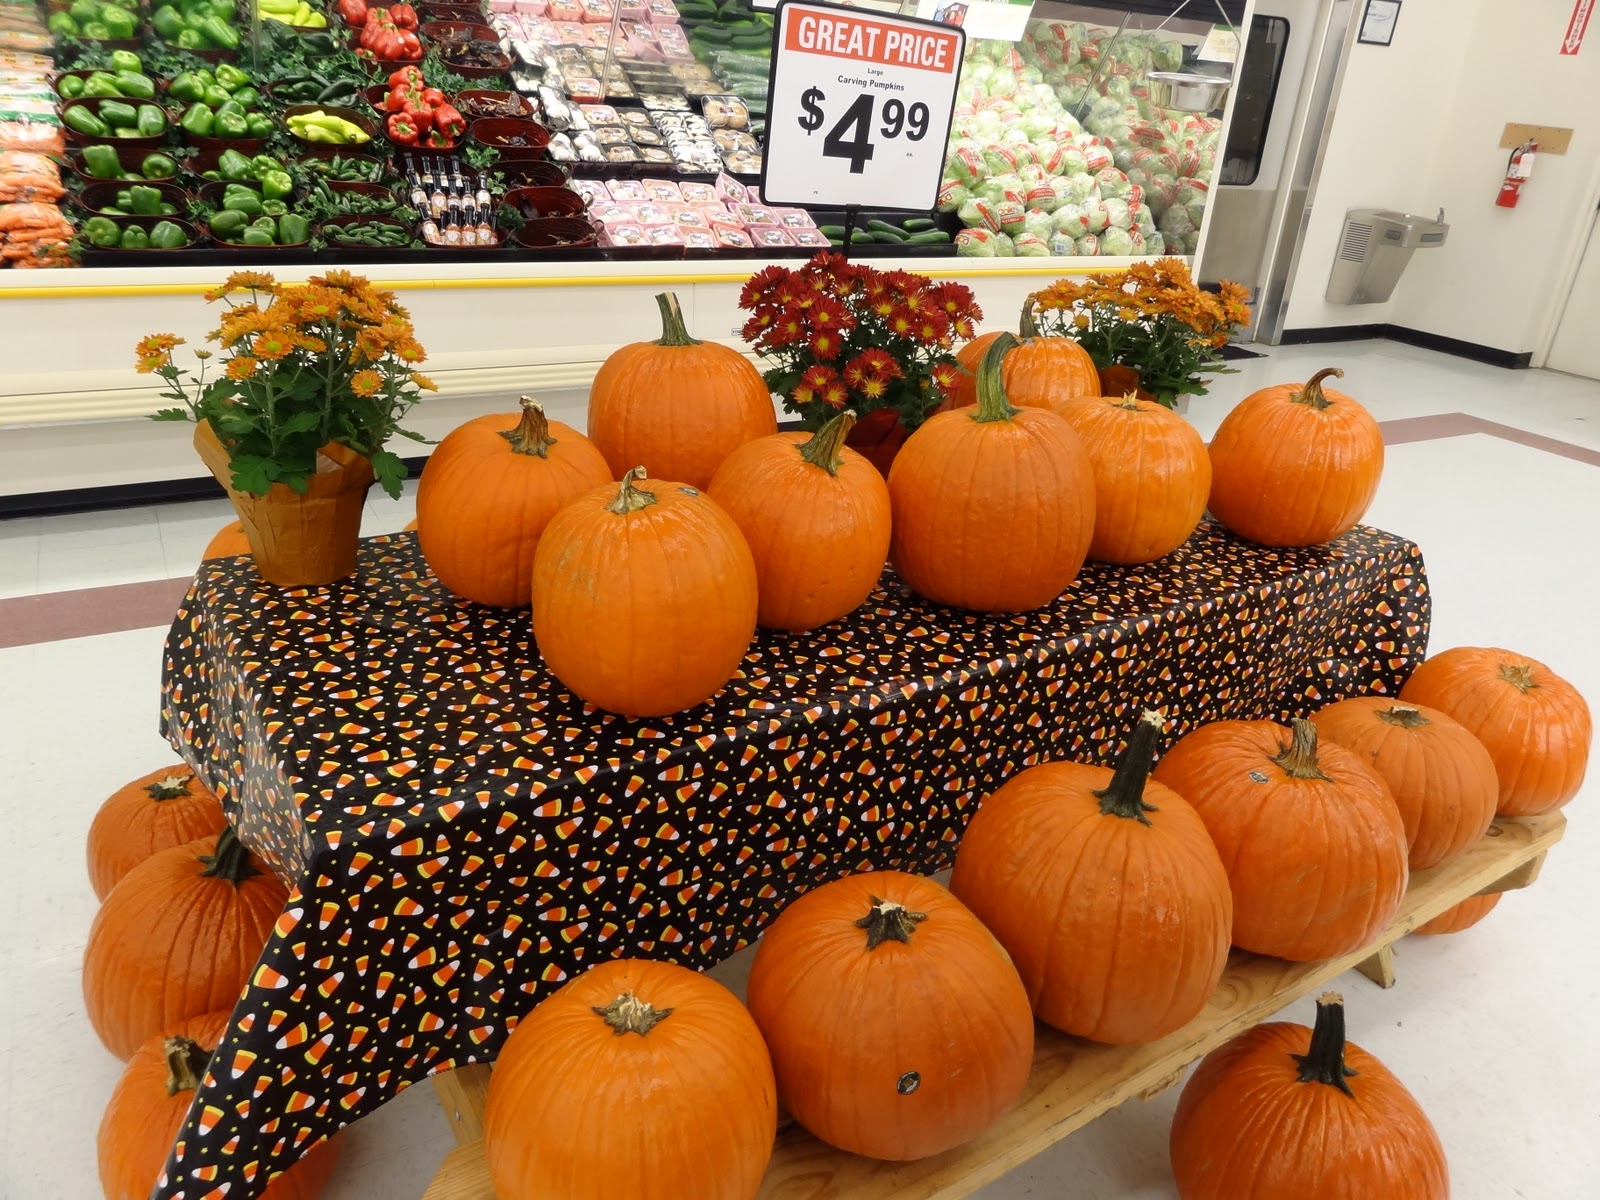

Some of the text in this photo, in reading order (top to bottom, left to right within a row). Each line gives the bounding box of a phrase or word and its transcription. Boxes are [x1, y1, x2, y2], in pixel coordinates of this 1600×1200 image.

[798, 16, 949, 69] GREAT PRICE
[867, 68, 884, 76] Large
[837, 75, 905, 91] Carving Pumpkins
